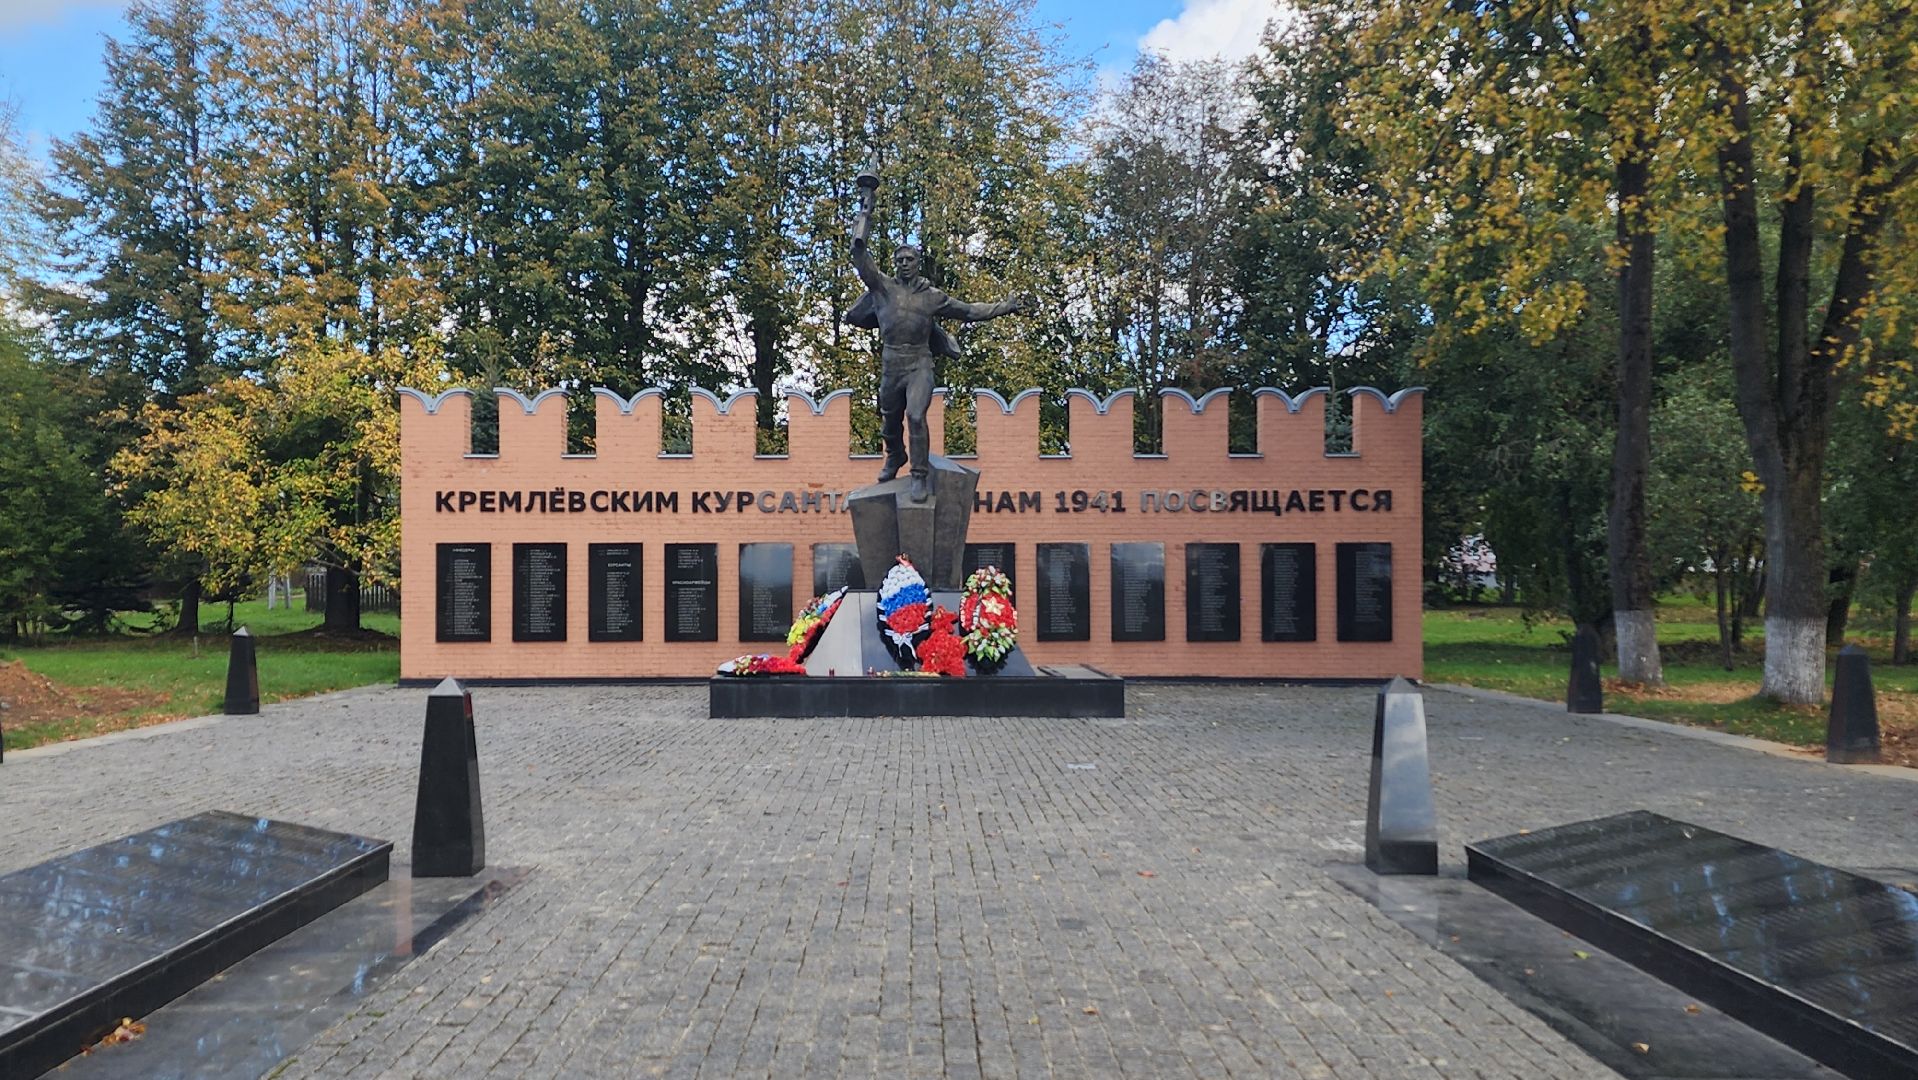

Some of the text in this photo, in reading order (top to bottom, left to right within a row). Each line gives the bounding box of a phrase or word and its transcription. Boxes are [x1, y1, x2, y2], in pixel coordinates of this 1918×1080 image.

[435, 487, 679, 513] КРЕМЛЁВСКИМ
[691, 490, 850, 513] КУРСАНТ
[1054, 490, 1126, 512] 1941
[1140, 489, 1393, 517] ПОСВЯЩАЕТСЯ
